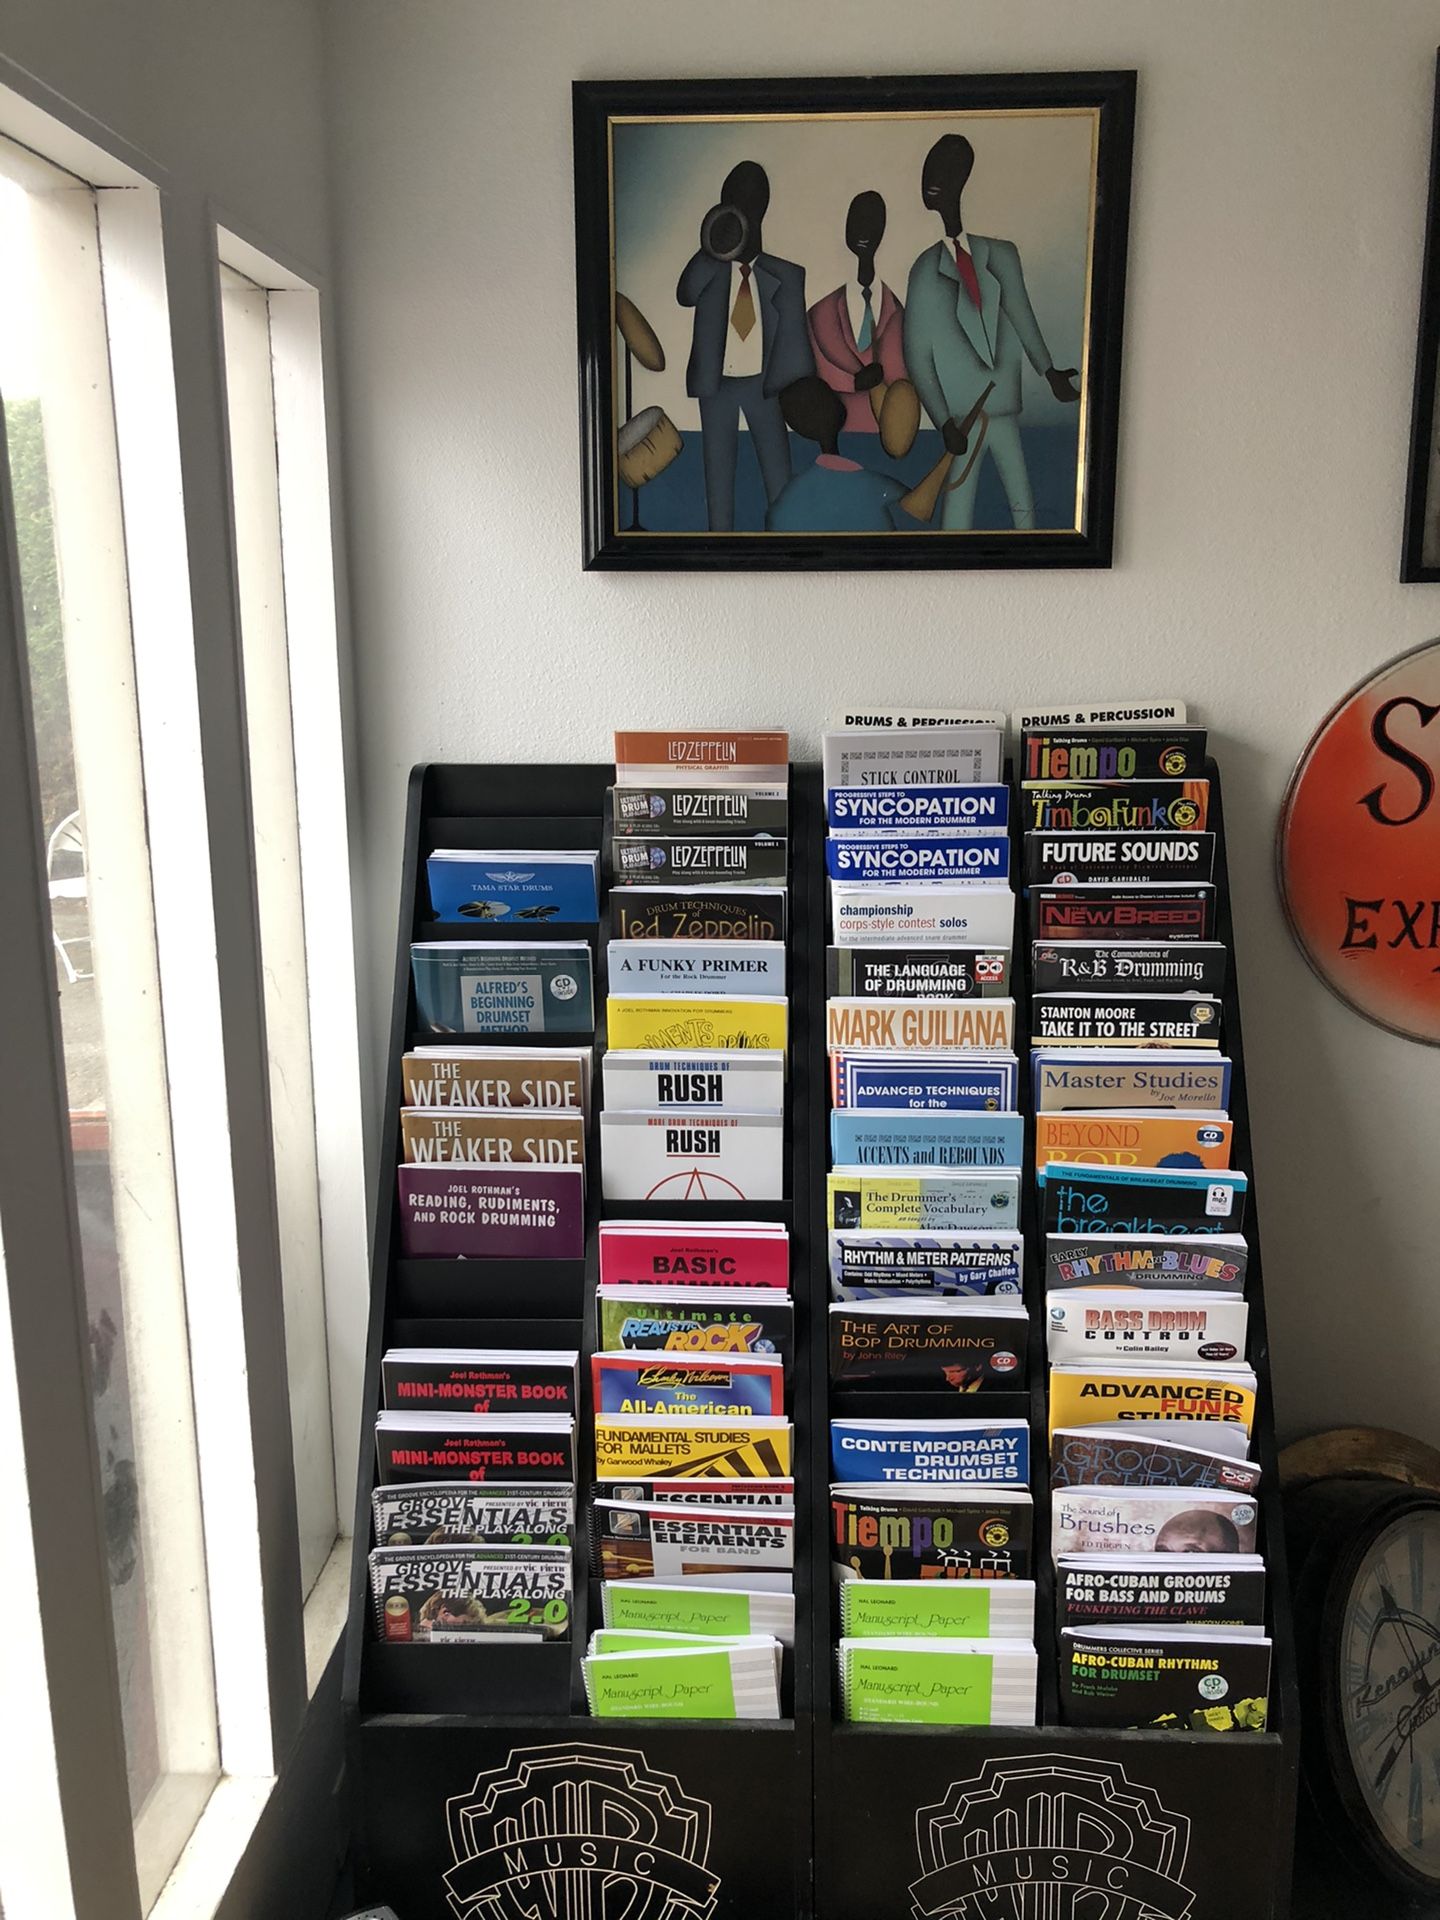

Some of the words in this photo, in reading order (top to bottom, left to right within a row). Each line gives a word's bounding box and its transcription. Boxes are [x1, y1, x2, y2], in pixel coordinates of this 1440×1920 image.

[846, 716, 892, 726] DRUMS
[898, 718, 907, 727] &
[1022, 715, 1070, 727] DRUMS
[1075, 713, 1085, 723] &
[1090, 708, 1175, 723] PERCUSSION
[1027, 738, 1136, 779] Tiempo
[861, 771, 897, 785] STICK
[904, 770, 960, 784] CONTROL
[1032, 790, 1061, 803] Talking
[835, 797, 995, 816] SYNCOPATION
[934, 816, 976, 824] DRUMMER
[838, 848, 999, 869] SYNCOPATION
[1043, 843, 1116, 862] FUTURE
[1121, 842, 1199, 862] SOUNDS
[647, 903, 678, 916] DRUM
[681, 901, 747, 916] TECHNIQUES
[840, 904, 913, 917] championship
[840, 918, 894, 931] corps-style
[898, 918, 936, 928] contest
[940, 917, 967, 928] solos
[1095, 950, 1108, 958] The
[1111, 950, 1161, 958] Commandments
[1163, 950, 1170, 958] of
[621, 960, 632, 971] A
[639, 959, 696, 972] FUNKY
[703, 960, 768, 972] PRIMER
[865, 965, 890, 976] THE
[895, 965, 966, 976] LANGUAGE
[1060, 958, 1107, 977] R&B
[1115, 959, 1204, 980] Drumming
[476, 982, 528, 994] ALFRED'S
[865, 980, 881, 991] OF
[886, 979, 966, 991] DRUMMING
[471, 996, 534, 1008] BEGINNING
[477, 1011, 530, 1022] DRUMSET
[1041, 1007, 1091, 1019] STANTON
[1095, 1008, 1136, 1019] MOORE
[829, 1008, 896, 1045] MARK
[902, 1010, 1007, 1046] GUILIANA
[1041, 1021, 1074, 1036] TAKE
[1079, 1022, 1090, 1036] IT
[1096, 1022, 1114, 1036] TO
[1120, 1022, 1145, 1036] THE
[1150, 1022, 1199, 1037] STREET
[432, 1063, 460, 1078] THE
[650, 1062, 670, 1070] DRUM
[674, 1062, 718, 1071] TECHNIQUES
[721, 1062, 729, 1071] OF
[1045, 1071, 1125, 1088] Master
[1133, 1072, 1218, 1088] Studies
[410, 1080, 511, 1107] WEAKER
[521, 1080, 577, 1108] SIDE
[658, 1075, 723, 1101] RUSH
[858, 1086, 923, 1096] ADVANCED
[926, 1087, 1000, 1096] TECHNIQUES
[1150, 1089, 1160, 1097] by
[1160, 1093, 1175, 1101] Joe
[432, 1122, 462, 1136] THE
[1047, 1123, 1139, 1146] BEYOND
[667, 1130, 720, 1153] RUSH
[856, 1146, 909, 1164] ACCENTS
[913, 1146, 935, 1164] and
[940, 1147, 1005, 1165] REBOUNDS
[448, 1185, 467, 1193] JOEL
[472, 1186, 520, 1195] ROTHMAN'S
[867, 1192, 889, 1202] The
[892, 1192, 956, 1202] Drummer's
[409, 1194, 472, 1209] READING,
[479, 1197, 560, 1213] RUDIMENTS,
[1057, 1186, 1108, 1214] the
[866, 1204, 921, 1215] Complete
[924, 1203, 988, 1215] Vocabulary
[414, 1212, 435, 1222] AND
[440, 1211, 475, 1224] ROCK
[482, 1212, 555, 1227] DRUMMING
[844, 1250, 894, 1264] RHYTHM
[896, 1252, 904, 1264] &
[907, 1253, 949, 1265] METER
[951, 1253, 1011, 1266] PATTERNS
[1051, 1247, 1088, 1264] EARLY
[653, 1257, 736, 1274] BASIC
[1058, 1251, 1155, 1281] RHYTHM
[1146, 1256, 1167, 1264] AND
[1162, 1251, 1240, 1281] BLUES
[637, 1309, 752, 1321] Ultimate
[1085, 1310, 1143, 1330] BASS
[1149, 1311, 1207, 1330] DRUM
[665, 1324, 762, 1351] ROCK
[1085, 1331, 1205, 1340] CONTROL
[398, 1383, 517, 1398] MINI-MONSTER
[522, 1385, 567, 1399] BOOK
[1080, 1384, 1243, 1404] ADVANCED
[620, 1399, 752, 1415] All-American
[1161, 1400, 1242, 1416] FUNK
[596, 1429, 692, 1442] FUNDAMENTAL
[695, 1432, 750, 1443] STUDIES
[597, 1442, 622, 1454] FOR
[630, 1443, 691, 1455] MALLETS
[842, 1438, 1019, 1452] CONTEMPORARY
[915, 1453, 1018, 1466] DRUMSET
[1064, 1442, 1219, 1484] GROOVE
[883, 1467, 1018, 1480] TECHNIQUES
[1062, 1504, 1077, 1512] The
[1079, 1506, 1105, 1516] Sound
[1107, 1508, 1116, 1516] of
[653, 1520, 787, 1538] ESSENTIAL
[832, 1501, 953, 1557] Tiempo
[1060, 1513, 1155, 1535] Brushes
[656, 1533, 785, 1548] ELEMENTS
[717, 1547, 760, 1555] BAND
[384, 1572, 565, 1594] ESSENTIALS
[1066, 1573, 1159, 1587] AFRO-CUBAN
[1164, 1575, 1231, 1588] GROOVES
[1066, 1588, 1094, 1601] FOR
[1099, 1590, 1134, 1602] BASS
[1139, 1590, 1170, 1602] AND
[1174, 1591, 1226, 1603] DRUMS
[508, 1599, 568, 1625] 2.0
[619, 1609, 684, 1623] Manuscript
[690, 1613, 730, 1623] Paper
[1067, 1604, 1141, 1614] FUNKIFYING
[1144, 1605, 1166, 1615] THE
[1170, 1606, 1207, 1616] CLAVE
[1073, 1643, 1107, 1651] DRUMMERS
[1109, 1646, 1143, 1654] COLLECTIVE
[1072, 1653, 1154, 1668] AFRO-CUBAN
[1158, 1658, 1218, 1670] RHYTHMS
[1072, 1665, 1097, 1678] FOR
[1102, 1668, 1160, 1681] DRUMSET
[855, 1679, 921, 1695] Manuscript
[923, 1682, 973, 1697] Paper
[503, 1842, 655, 1875] MUSIC
[973, 1856, 1128, 1889] MUSIC
